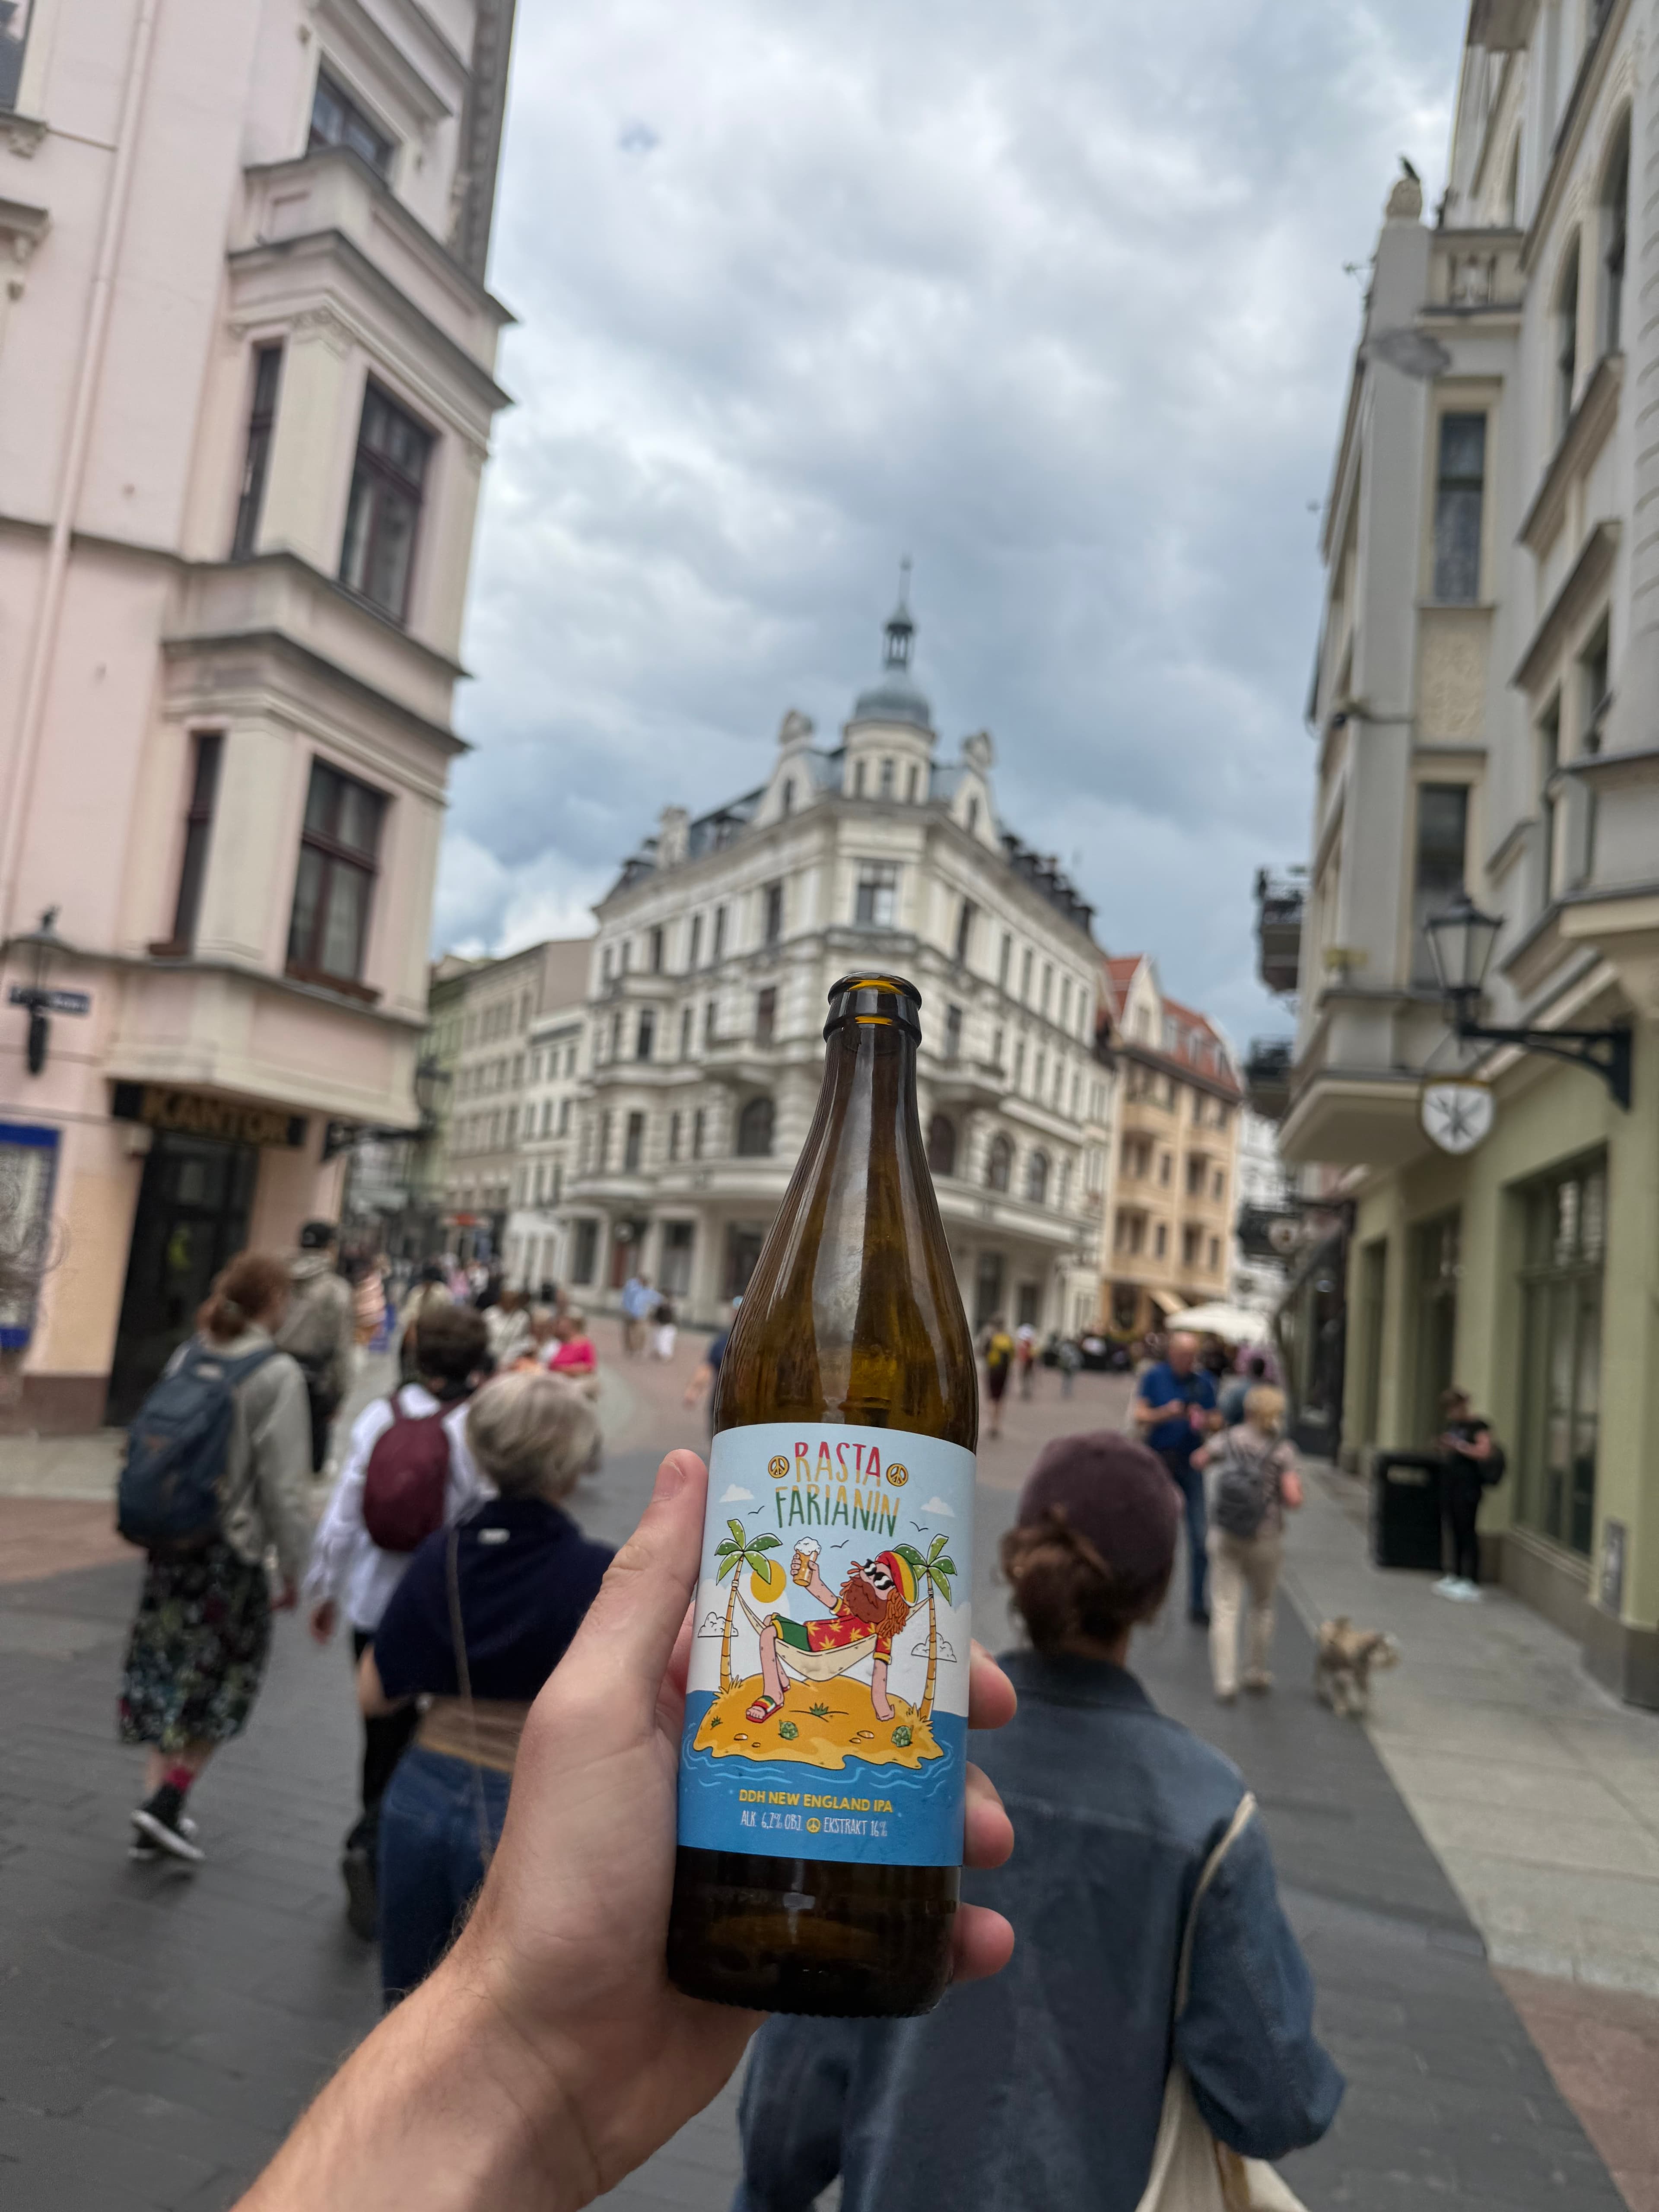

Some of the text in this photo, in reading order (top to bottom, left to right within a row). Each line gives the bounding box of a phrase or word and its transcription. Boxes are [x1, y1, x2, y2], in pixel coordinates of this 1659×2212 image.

[794, 1441, 881, 1487] RASTA
[775, 1483, 900, 1537] FARIANIN
[739, 1789, 893, 1813] DDH NEW ENGLAND IPA
[823, 1817, 868, 1835] EKSTRAKT
